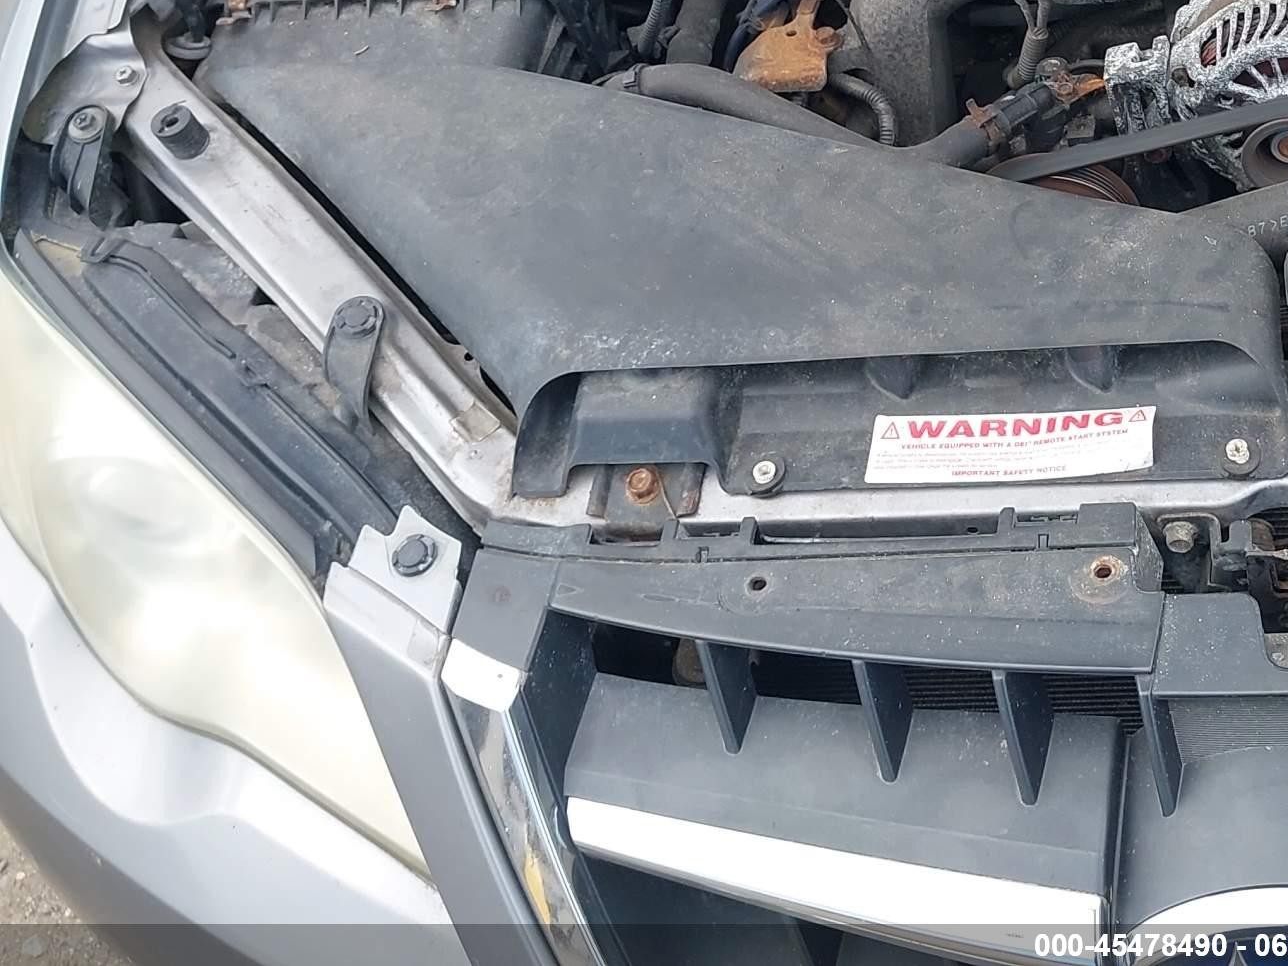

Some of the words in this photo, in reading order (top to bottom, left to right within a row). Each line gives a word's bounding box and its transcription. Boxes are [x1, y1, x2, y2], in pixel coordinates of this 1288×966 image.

[908, 411, 1123, 439] WARNING
[1033, 437, 1065, 445] REMOTE
[1068, 433, 1094, 441] START
[1096, 429, 1129, 437] SYSTEM
